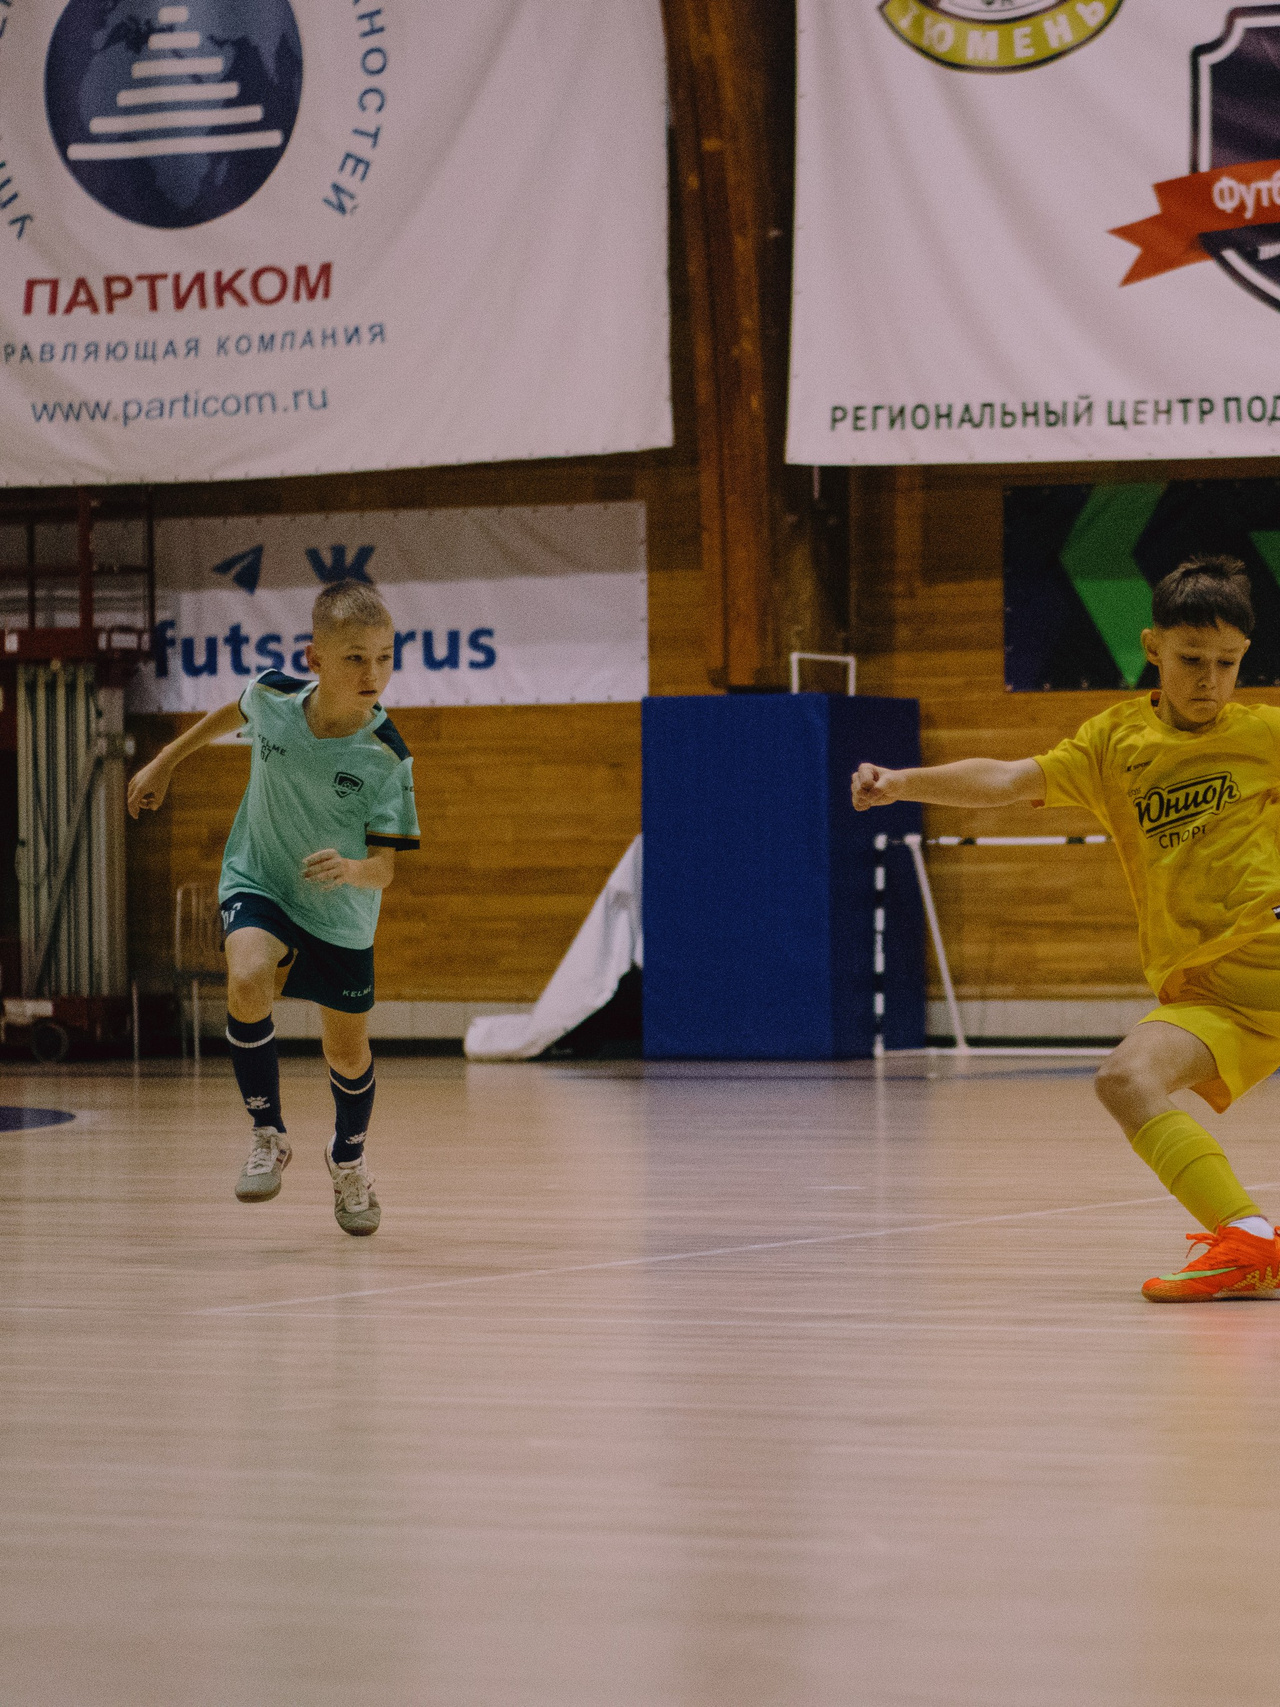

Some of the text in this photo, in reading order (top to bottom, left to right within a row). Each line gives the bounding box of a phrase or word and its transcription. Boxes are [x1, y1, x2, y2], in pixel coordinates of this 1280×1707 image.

[896, 1, 1107, 61] ТЮМЕНЬ
[21, 262, 334, 317] ПАРТИКОМ
[216, 321, 388, 357] КОМПАНИЯ
[31, 384, 329, 427] www.particom.ru
[829, 394, 1094, 432] РЕГИОНАЛЬНЫЙ
[1106, 396, 1215, 430] ЦЕНТР
[1135, 776, 1238, 828] Юниор
